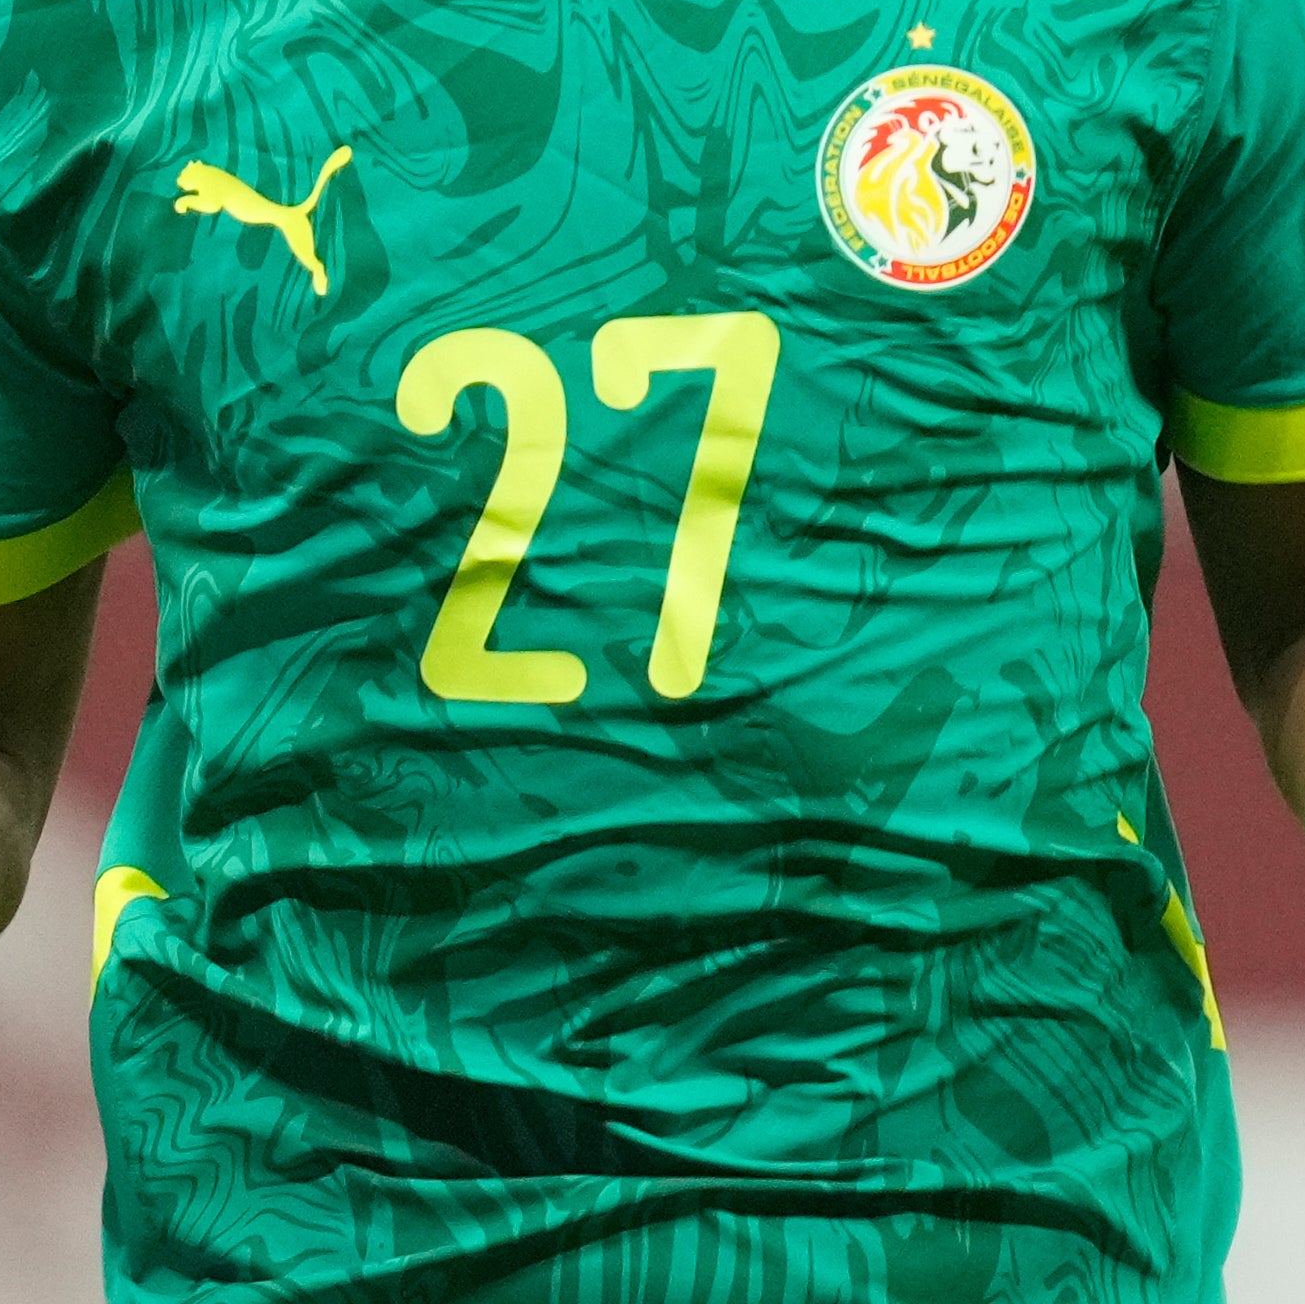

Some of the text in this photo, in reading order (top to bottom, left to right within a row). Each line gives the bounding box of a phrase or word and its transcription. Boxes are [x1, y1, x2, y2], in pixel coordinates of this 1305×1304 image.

[892, 72, 1025, 153] SÉNÉGALAISE
[902, 192, 1024, 281] DE FOOTBALL
[396, 311, 780, 703] 27
